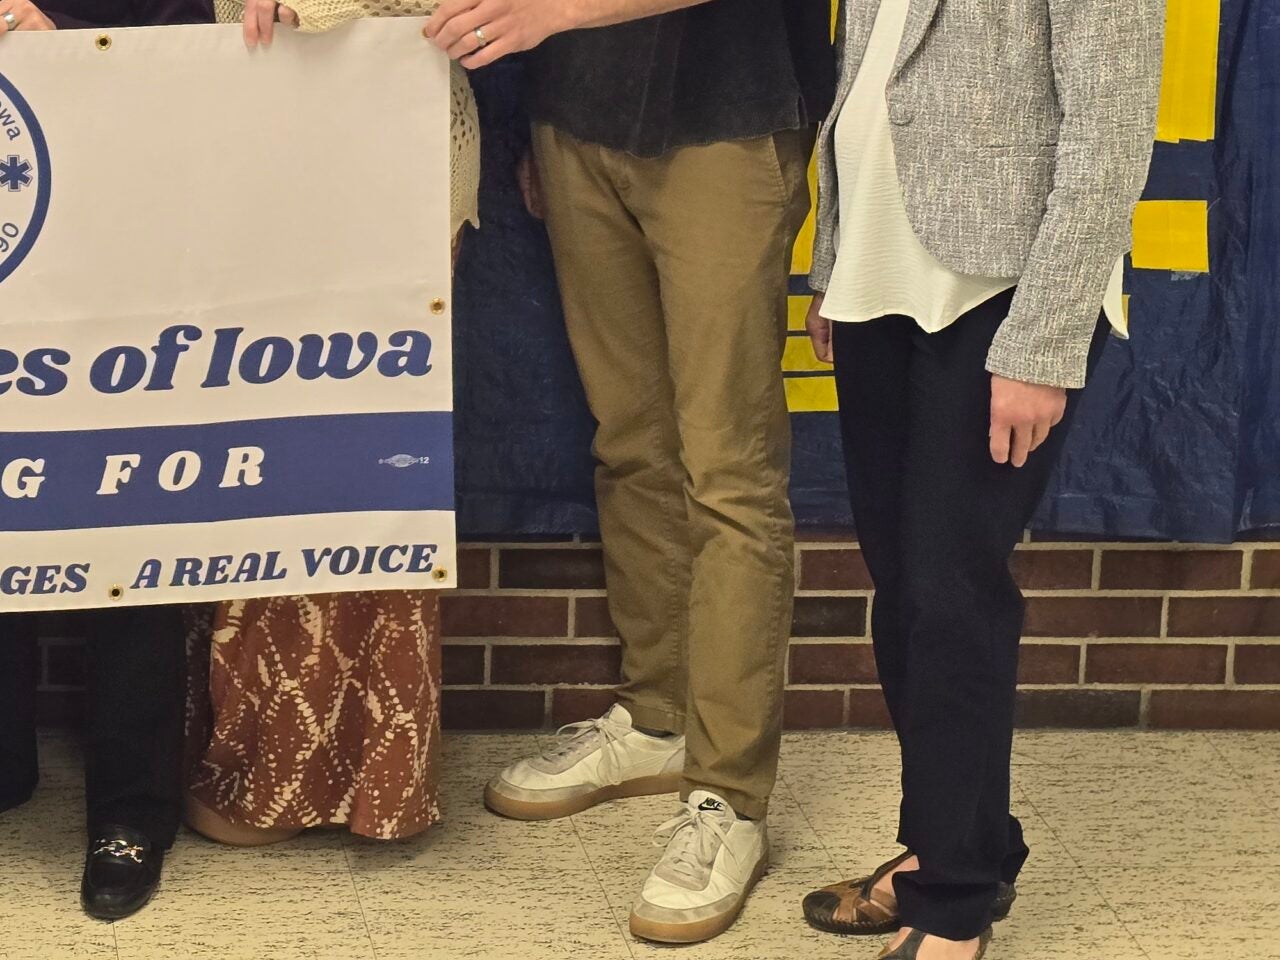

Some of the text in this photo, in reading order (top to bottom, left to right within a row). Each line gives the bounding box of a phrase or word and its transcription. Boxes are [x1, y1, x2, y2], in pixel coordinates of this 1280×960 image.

[88, 324, 203, 395] of
[200, 326, 433, 389] Iowa
[95, 445, 266, 496] FOR
[129, 557, 162, 590] A
[167, 550, 288, 587] REAL
[300, 542, 438, 578] VOICE
